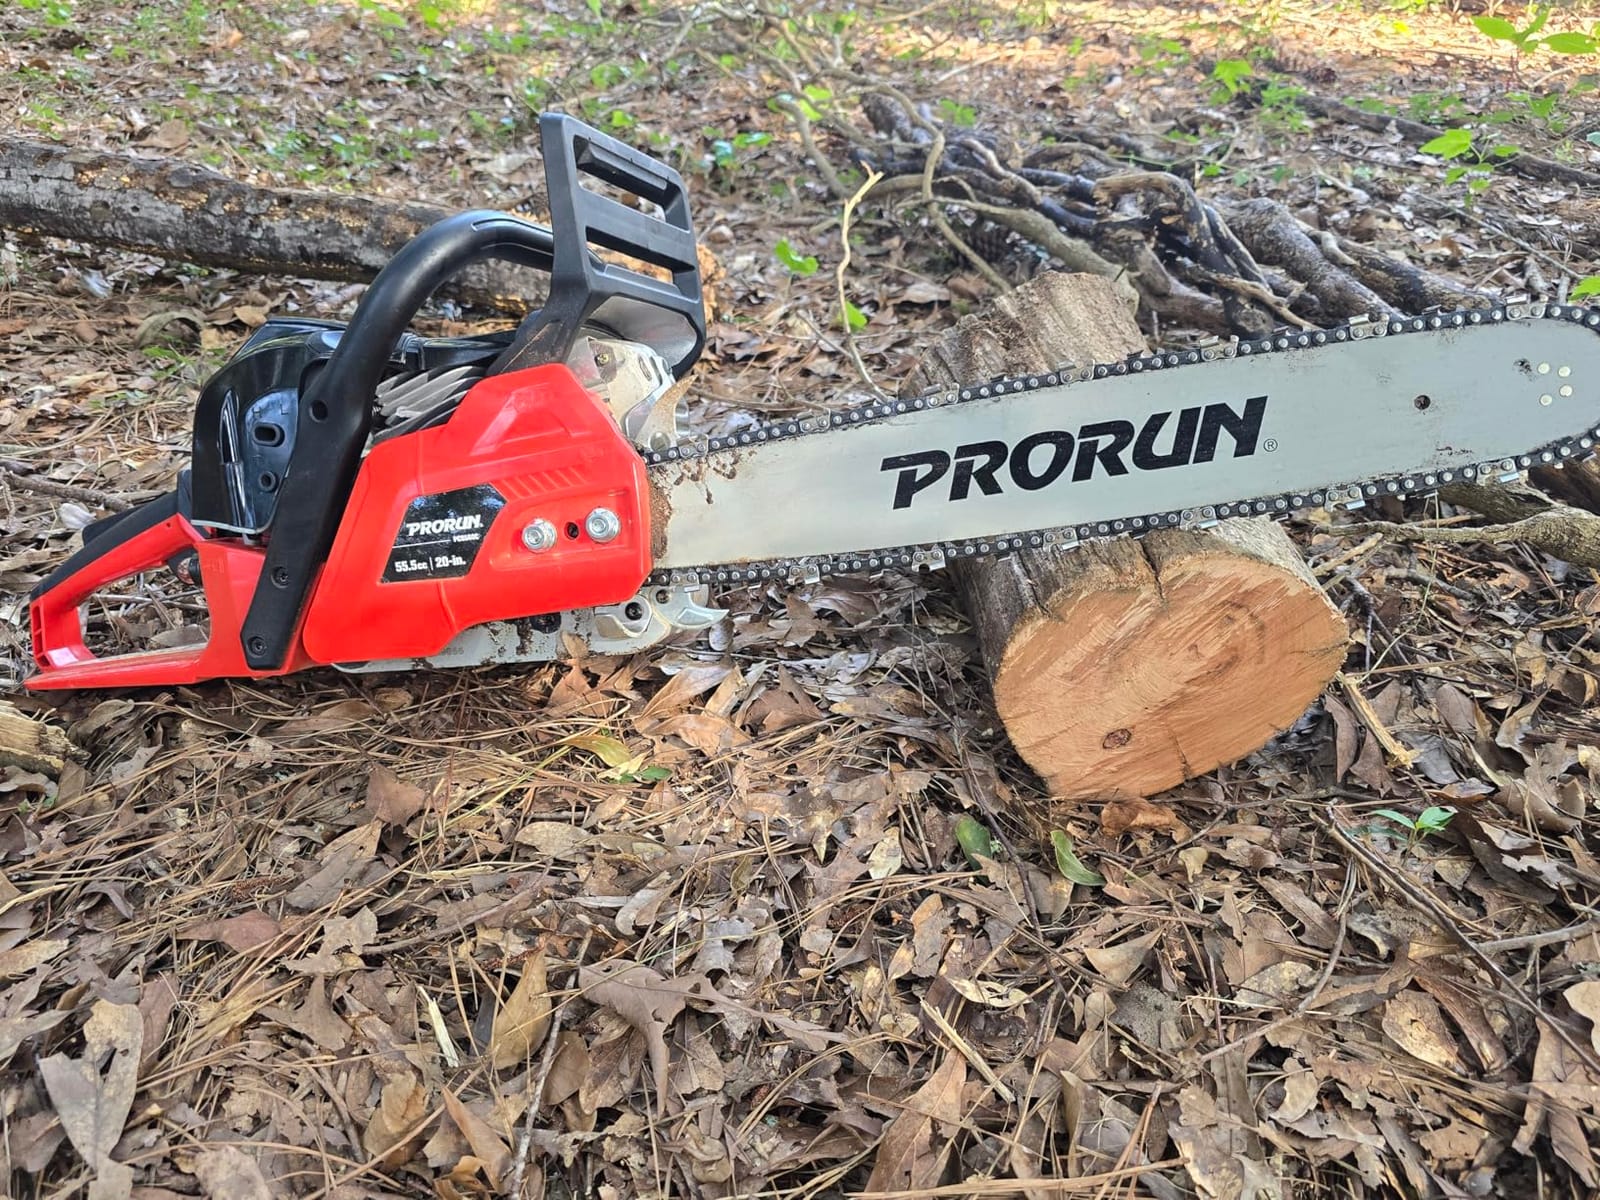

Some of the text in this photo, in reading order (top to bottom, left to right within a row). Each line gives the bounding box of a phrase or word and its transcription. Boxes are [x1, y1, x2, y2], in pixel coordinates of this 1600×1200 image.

[880, 395, 1268, 510] PRORUN
[406, 514, 481, 536] PRORUN
[394, 555, 466, 572] 55.5cc 20-in.
